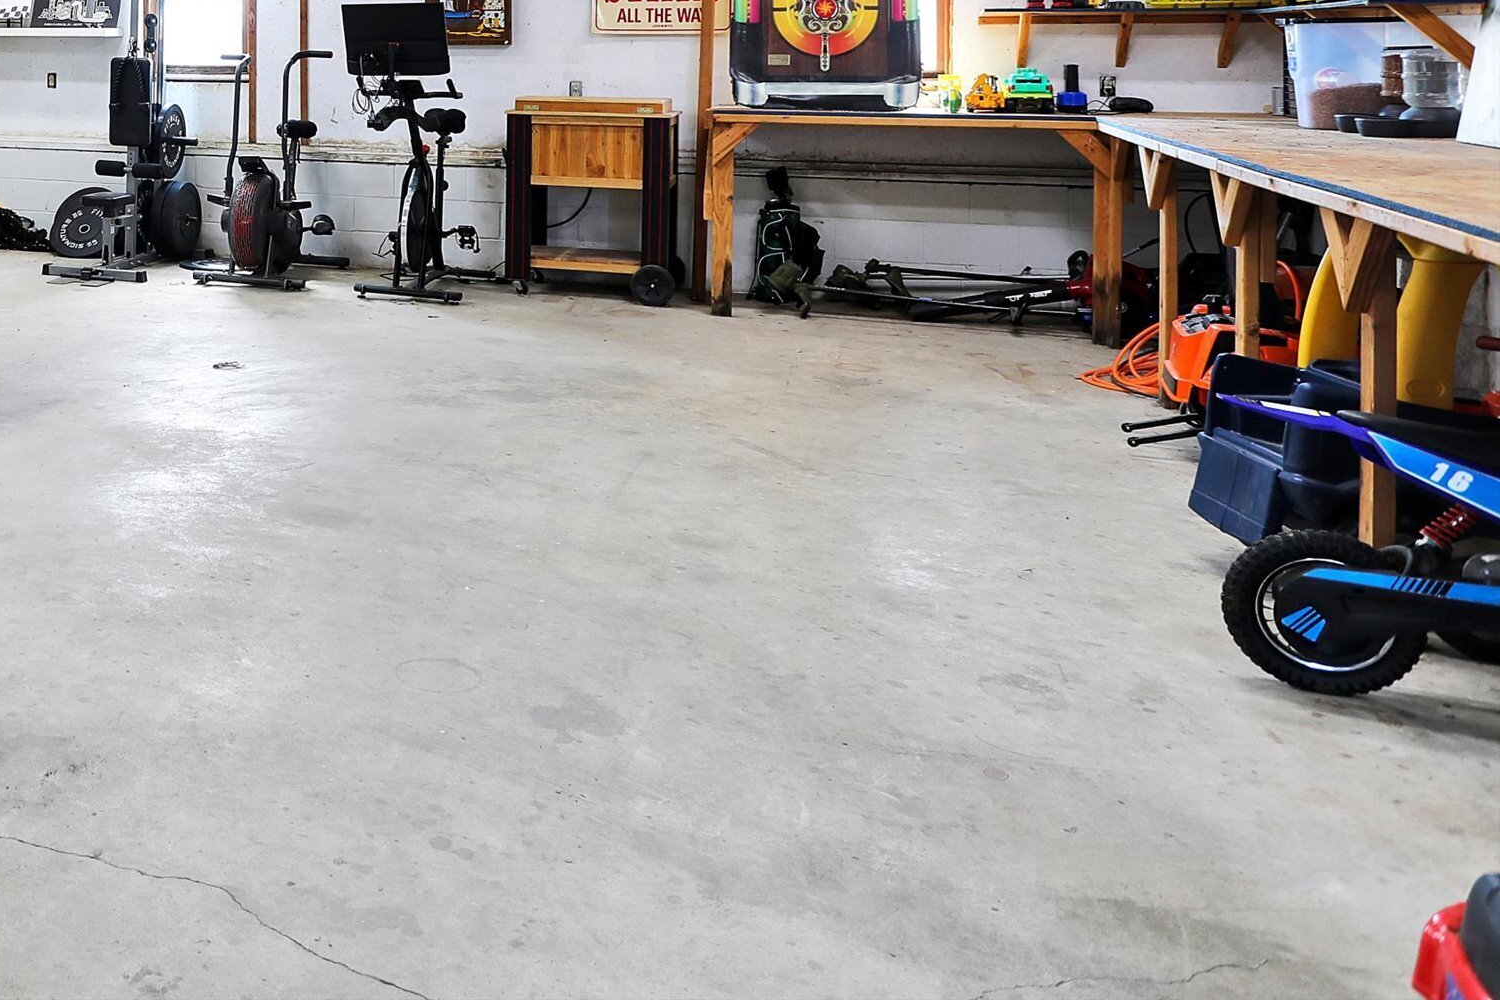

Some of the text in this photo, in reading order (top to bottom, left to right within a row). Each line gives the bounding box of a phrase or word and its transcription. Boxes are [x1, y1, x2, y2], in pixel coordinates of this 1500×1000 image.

[617, 8, 703, 23] ALL THE WA
